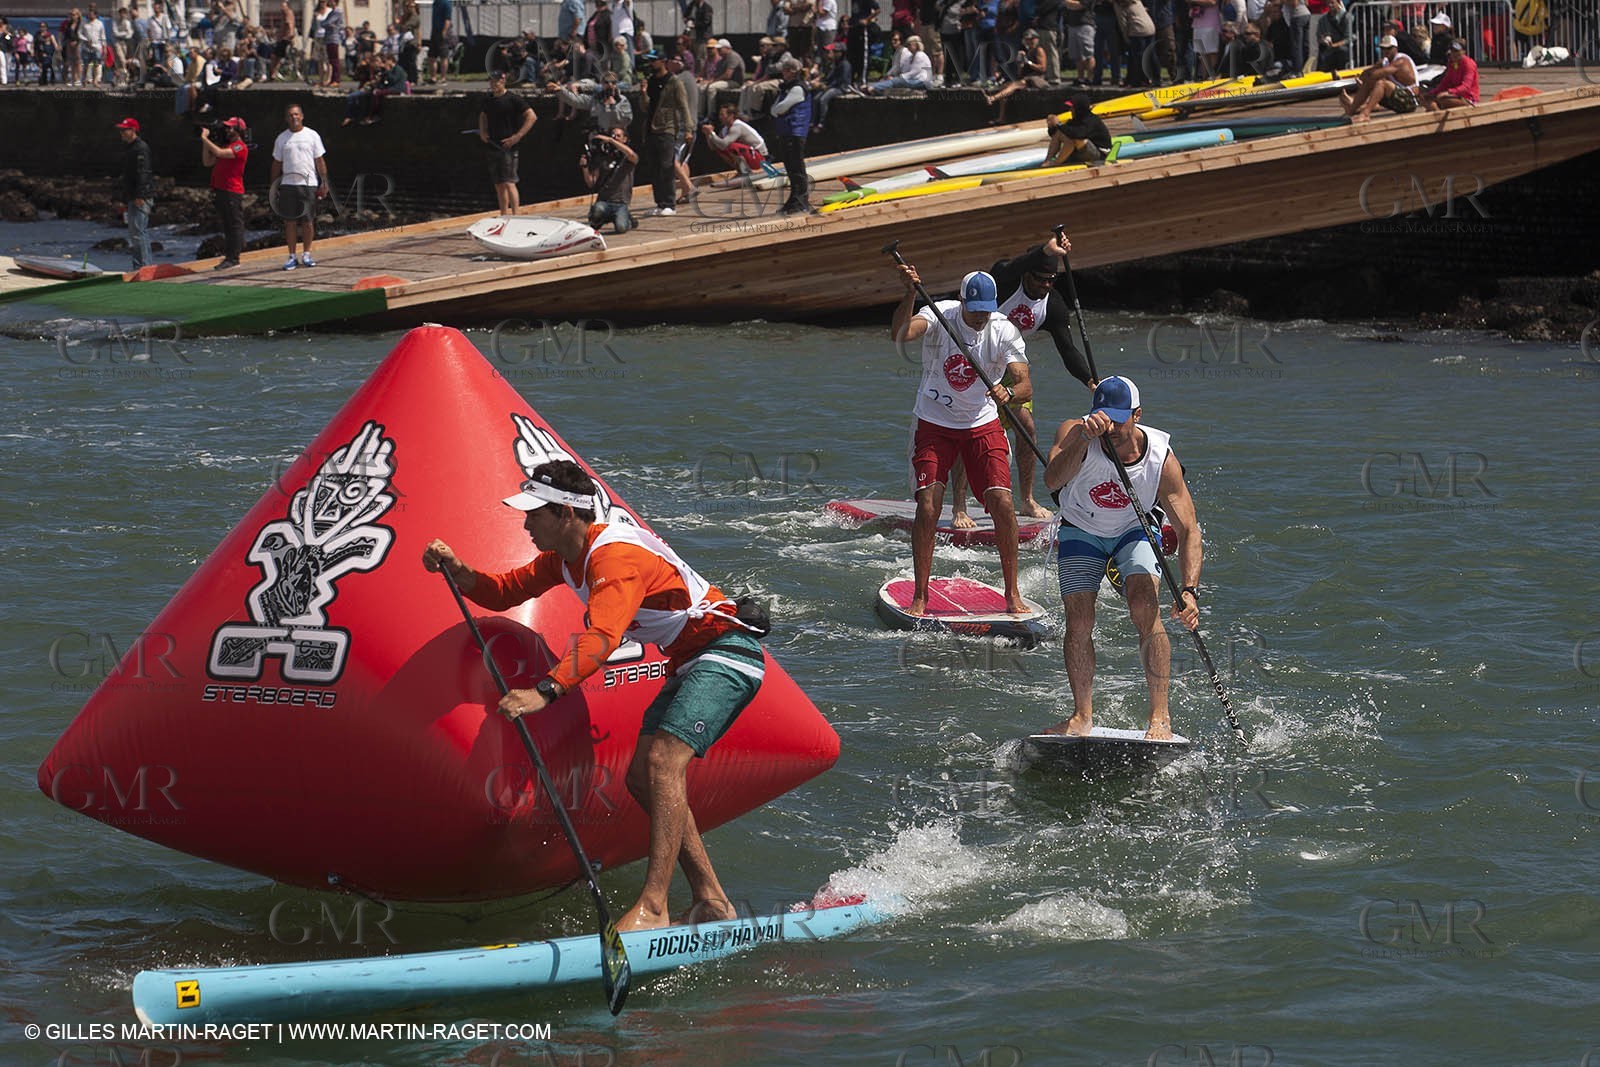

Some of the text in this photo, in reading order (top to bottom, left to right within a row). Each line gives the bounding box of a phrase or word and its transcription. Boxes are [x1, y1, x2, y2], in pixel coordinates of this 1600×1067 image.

[203, 685, 337, 709] STARBOARD
[1211, 674, 1240, 727] KAENON
[648, 933, 700, 960] FOCUS
[732, 922, 784, 947] HAWAII
